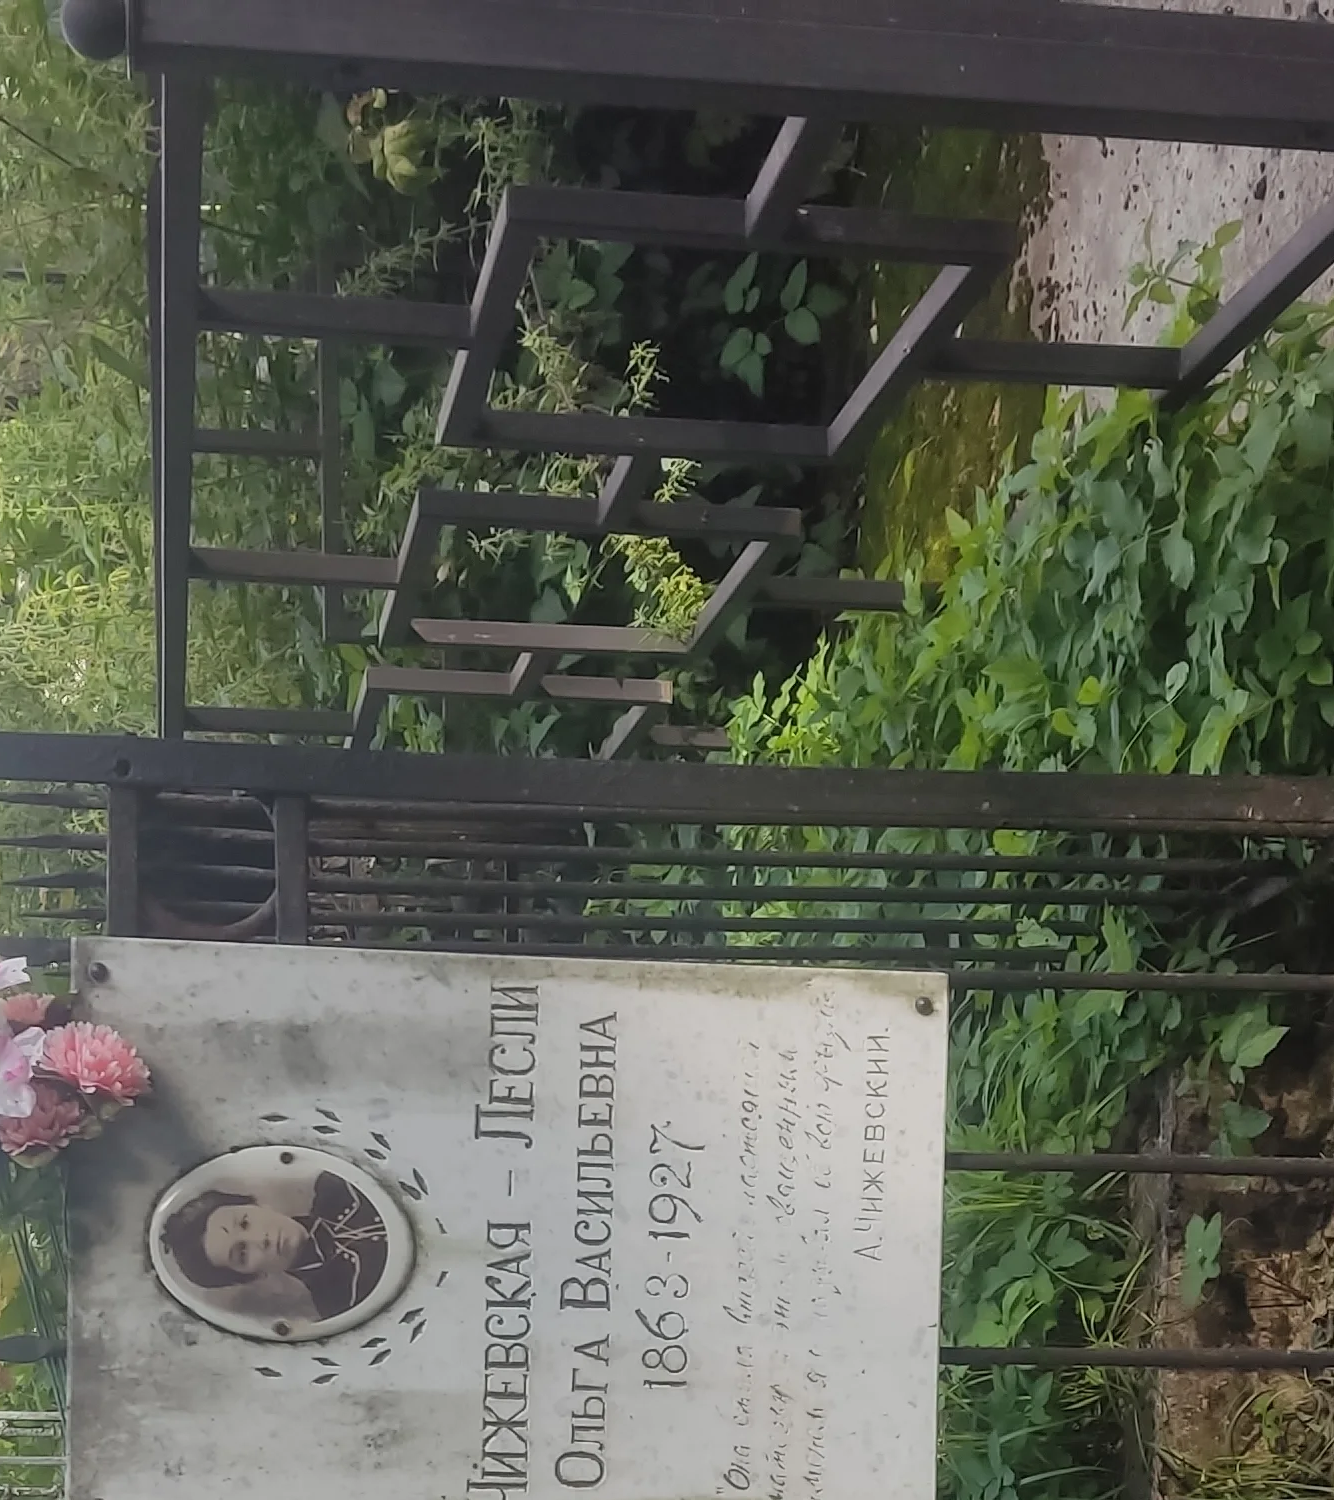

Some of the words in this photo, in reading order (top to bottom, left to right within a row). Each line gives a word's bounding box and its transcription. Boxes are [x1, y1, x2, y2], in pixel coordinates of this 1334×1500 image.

[472, 982, 540, 1150] ЛЕСЛИ
[558, 1010, 618, 1312] ВАСИЛЬЕВНА
[634, 1119, 706, 1391] 1863-1927
[553, 1332, 612, 1490] ОЛЬГА
